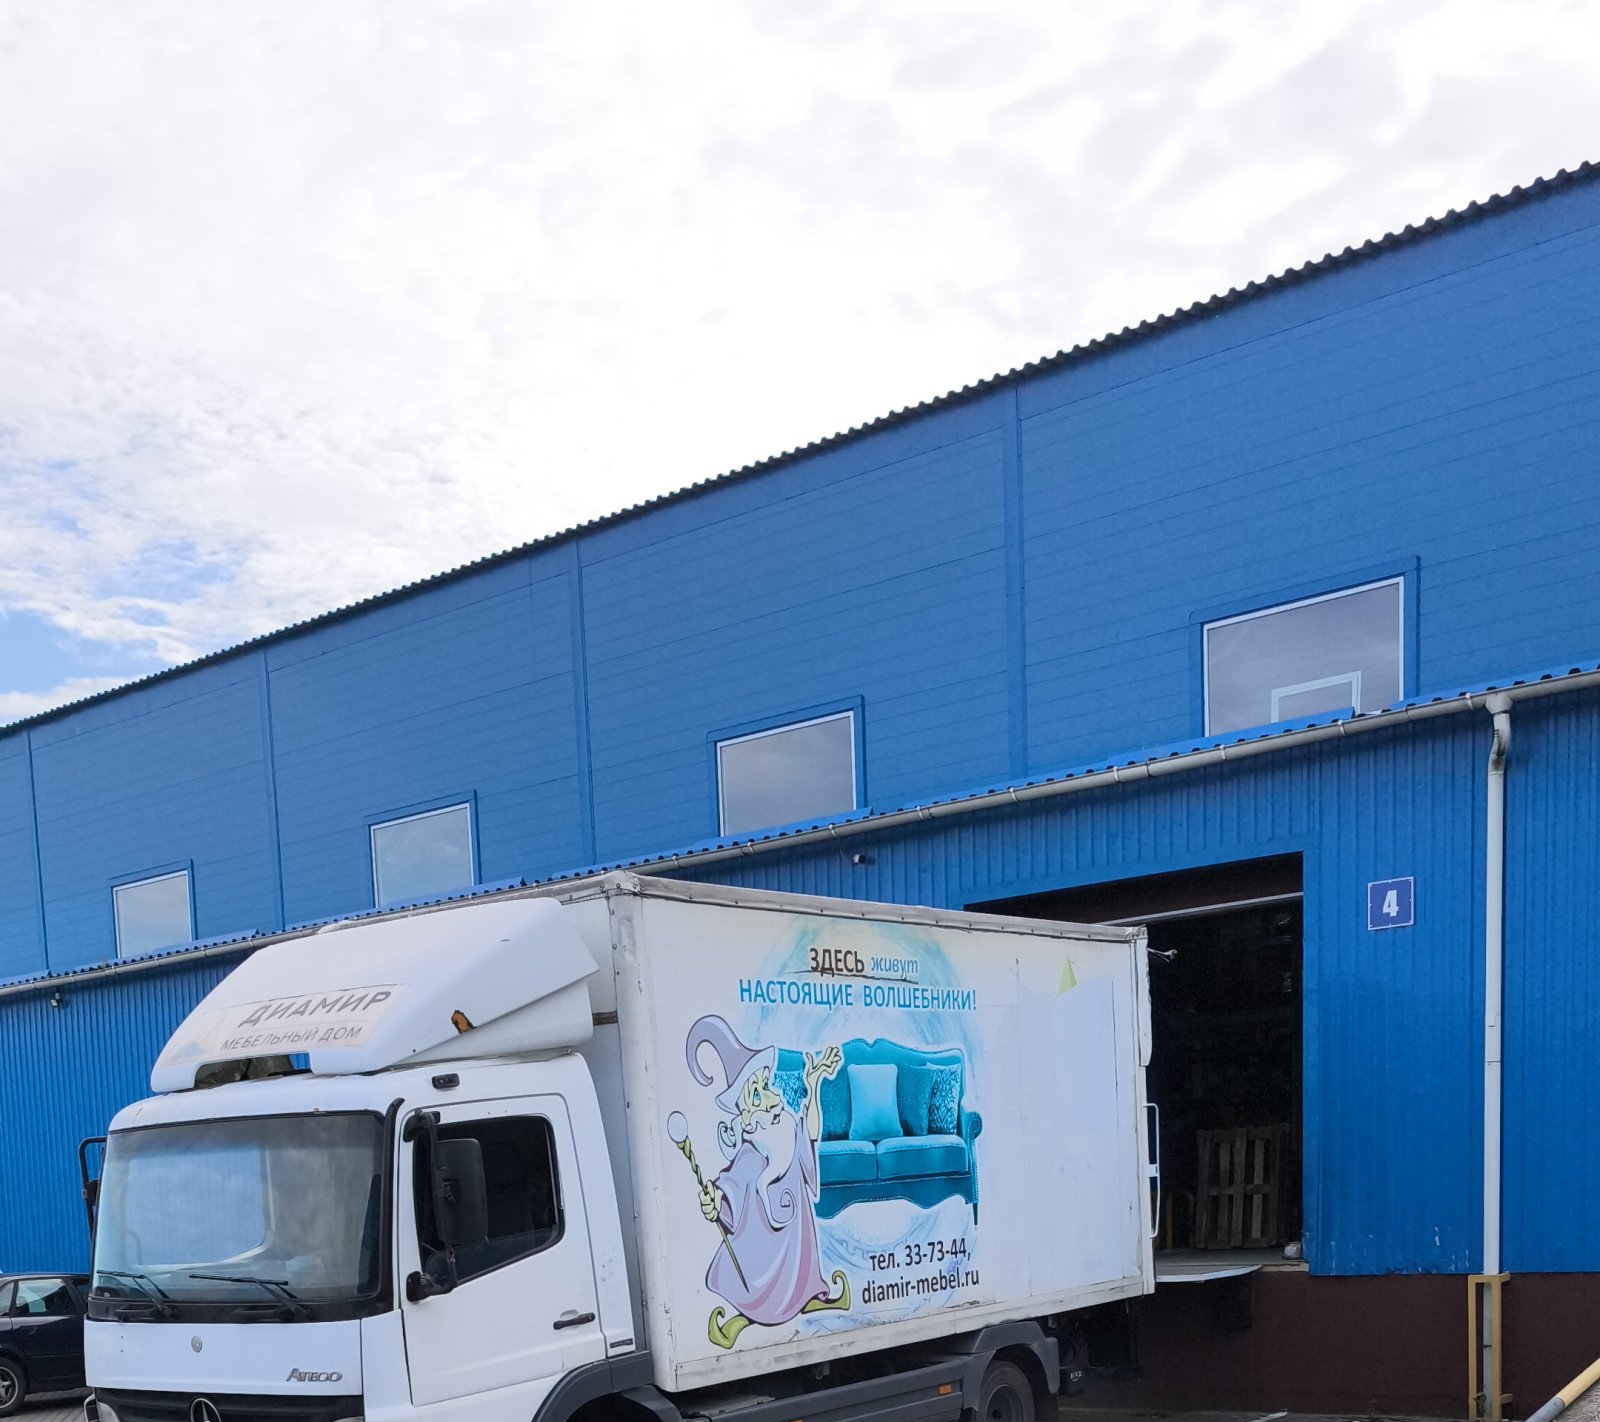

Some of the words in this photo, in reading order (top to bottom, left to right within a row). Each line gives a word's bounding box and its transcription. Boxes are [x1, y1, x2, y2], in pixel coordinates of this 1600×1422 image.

[1382, 889, 1399, 917] 4
[809, 947, 865, 977] ЗДЕСЬ
[870, 957, 919, 979] живут
[237, 991, 392, 1028] ДИАМИР
[739, 979, 854, 1011] НАСТОЯЩИЕ
[863, 985, 977, 1010] ВОЛШЕБНИКИ!
[219, 1027, 321, 1051] МЕБЕЛЬНЫЙ
[318, 1026, 364, 1043] ДОМ
[869, 1252, 900, 1271] тел.
[904, 1237, 971, 1266] 33-73-44,
[862, 1266, 980, 1304] diamir-mebel.ru
